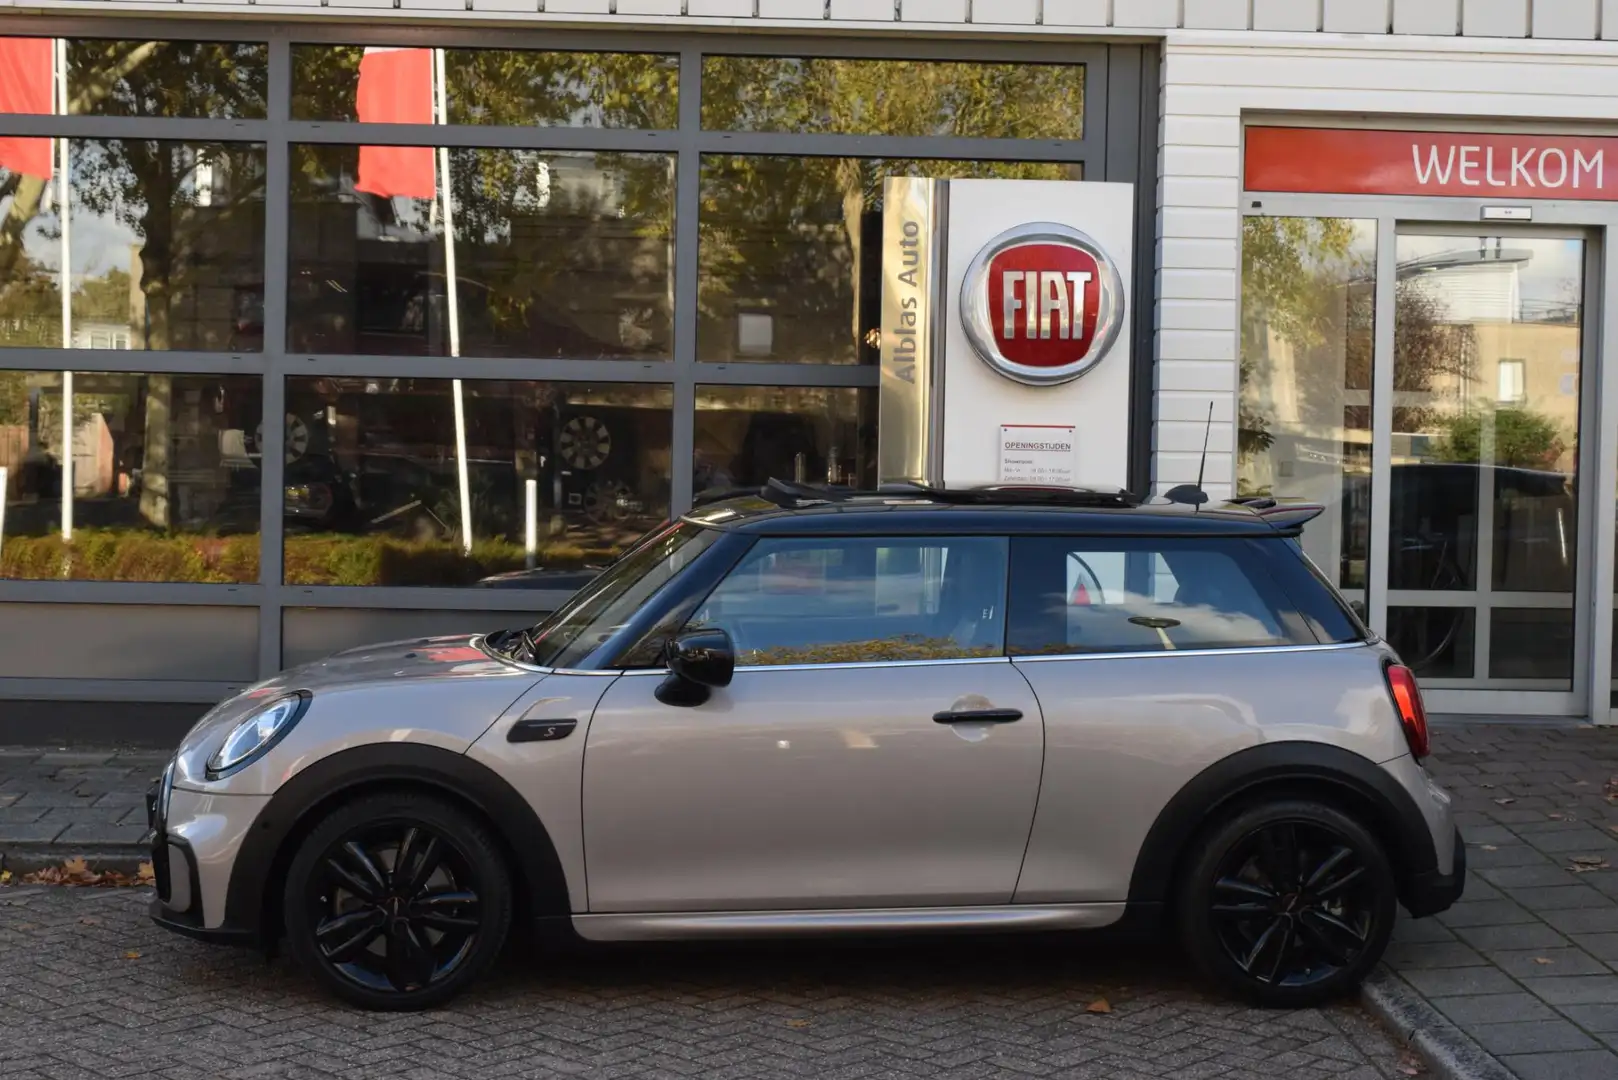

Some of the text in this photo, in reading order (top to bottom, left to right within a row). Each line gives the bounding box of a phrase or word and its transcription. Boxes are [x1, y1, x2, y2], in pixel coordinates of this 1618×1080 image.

[1412, 144, 1604, 189] WELKOM
[893, 220, 919, 385] Alblas Auto
[1002, 270, 1092, 340] FIAT
[1004, 441, 1071, 450] OPENINGSTIJDEN
